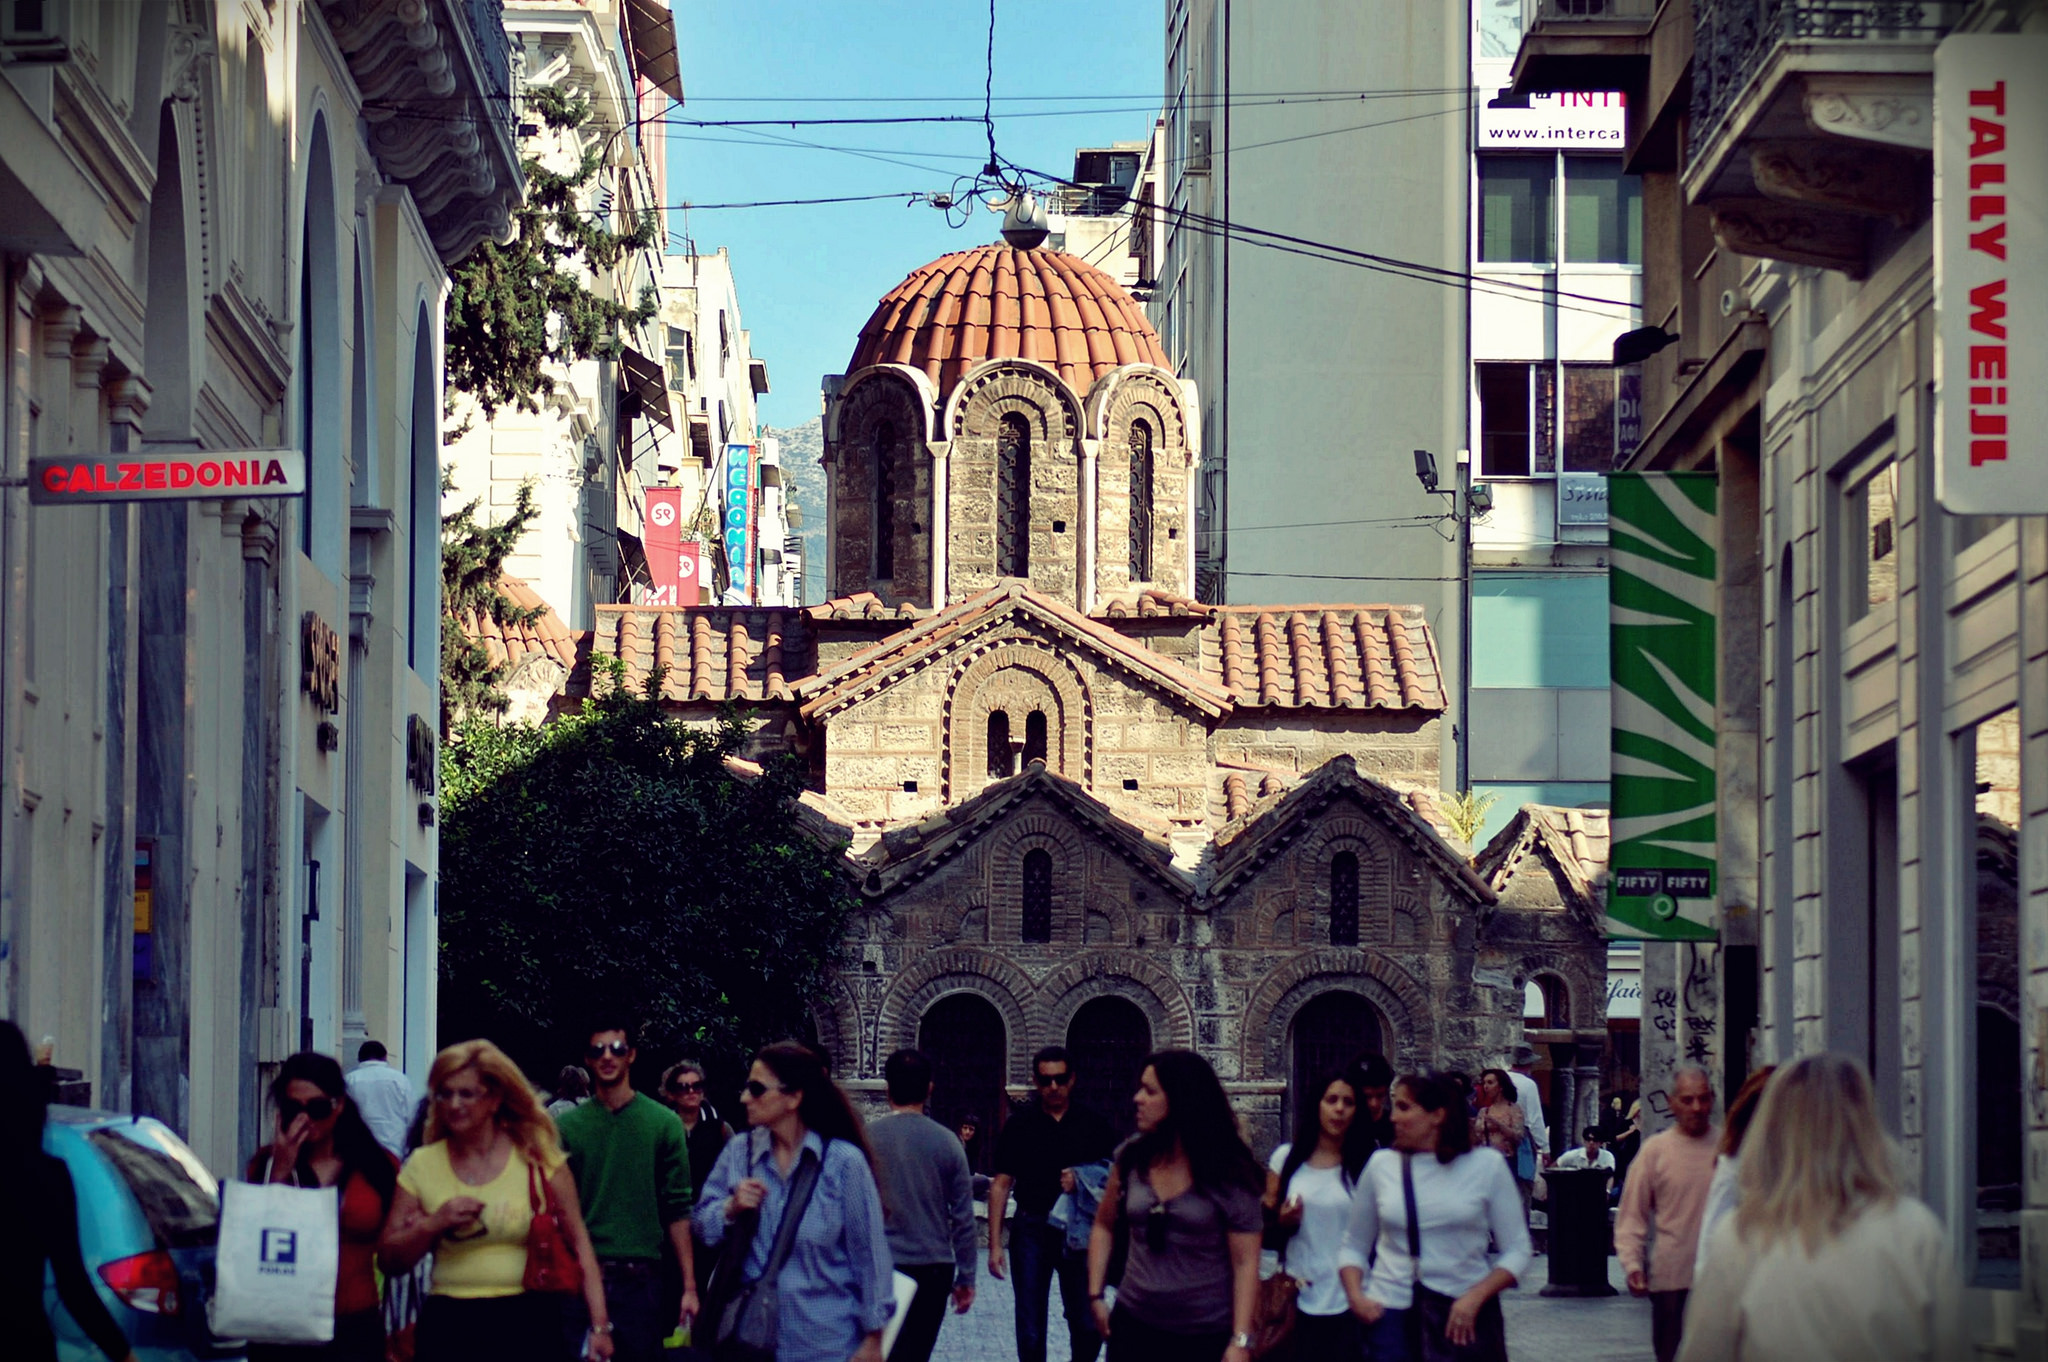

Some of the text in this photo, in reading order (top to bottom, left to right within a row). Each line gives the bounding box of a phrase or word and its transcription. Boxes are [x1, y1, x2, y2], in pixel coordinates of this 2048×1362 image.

[1968, 80, 2007, 261] TALLY
[42, 459, 288, 493] CALZEDONIA
[1617, 876, 1708, 889] FIFTY FIFTY
